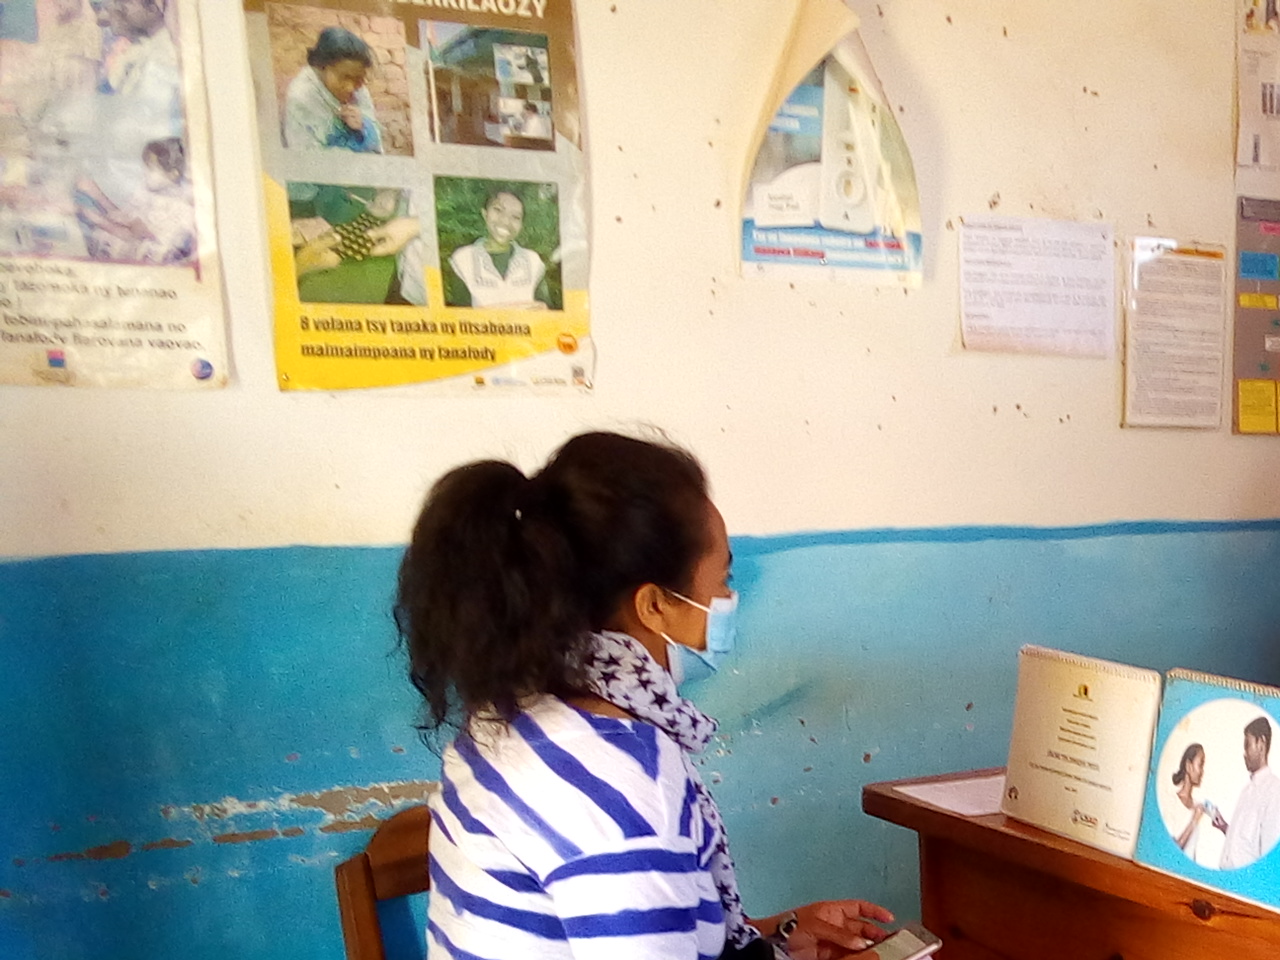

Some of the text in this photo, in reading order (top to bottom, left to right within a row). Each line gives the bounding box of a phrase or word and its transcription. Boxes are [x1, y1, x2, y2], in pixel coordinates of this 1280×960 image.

[313, 317, 363, 334] volana
[366, 318, 387, 335] tsy
[390, 320, 438, 336] tapaka
[441, 322, 455, 336] ny
[419, 347, 435, 361] ny
